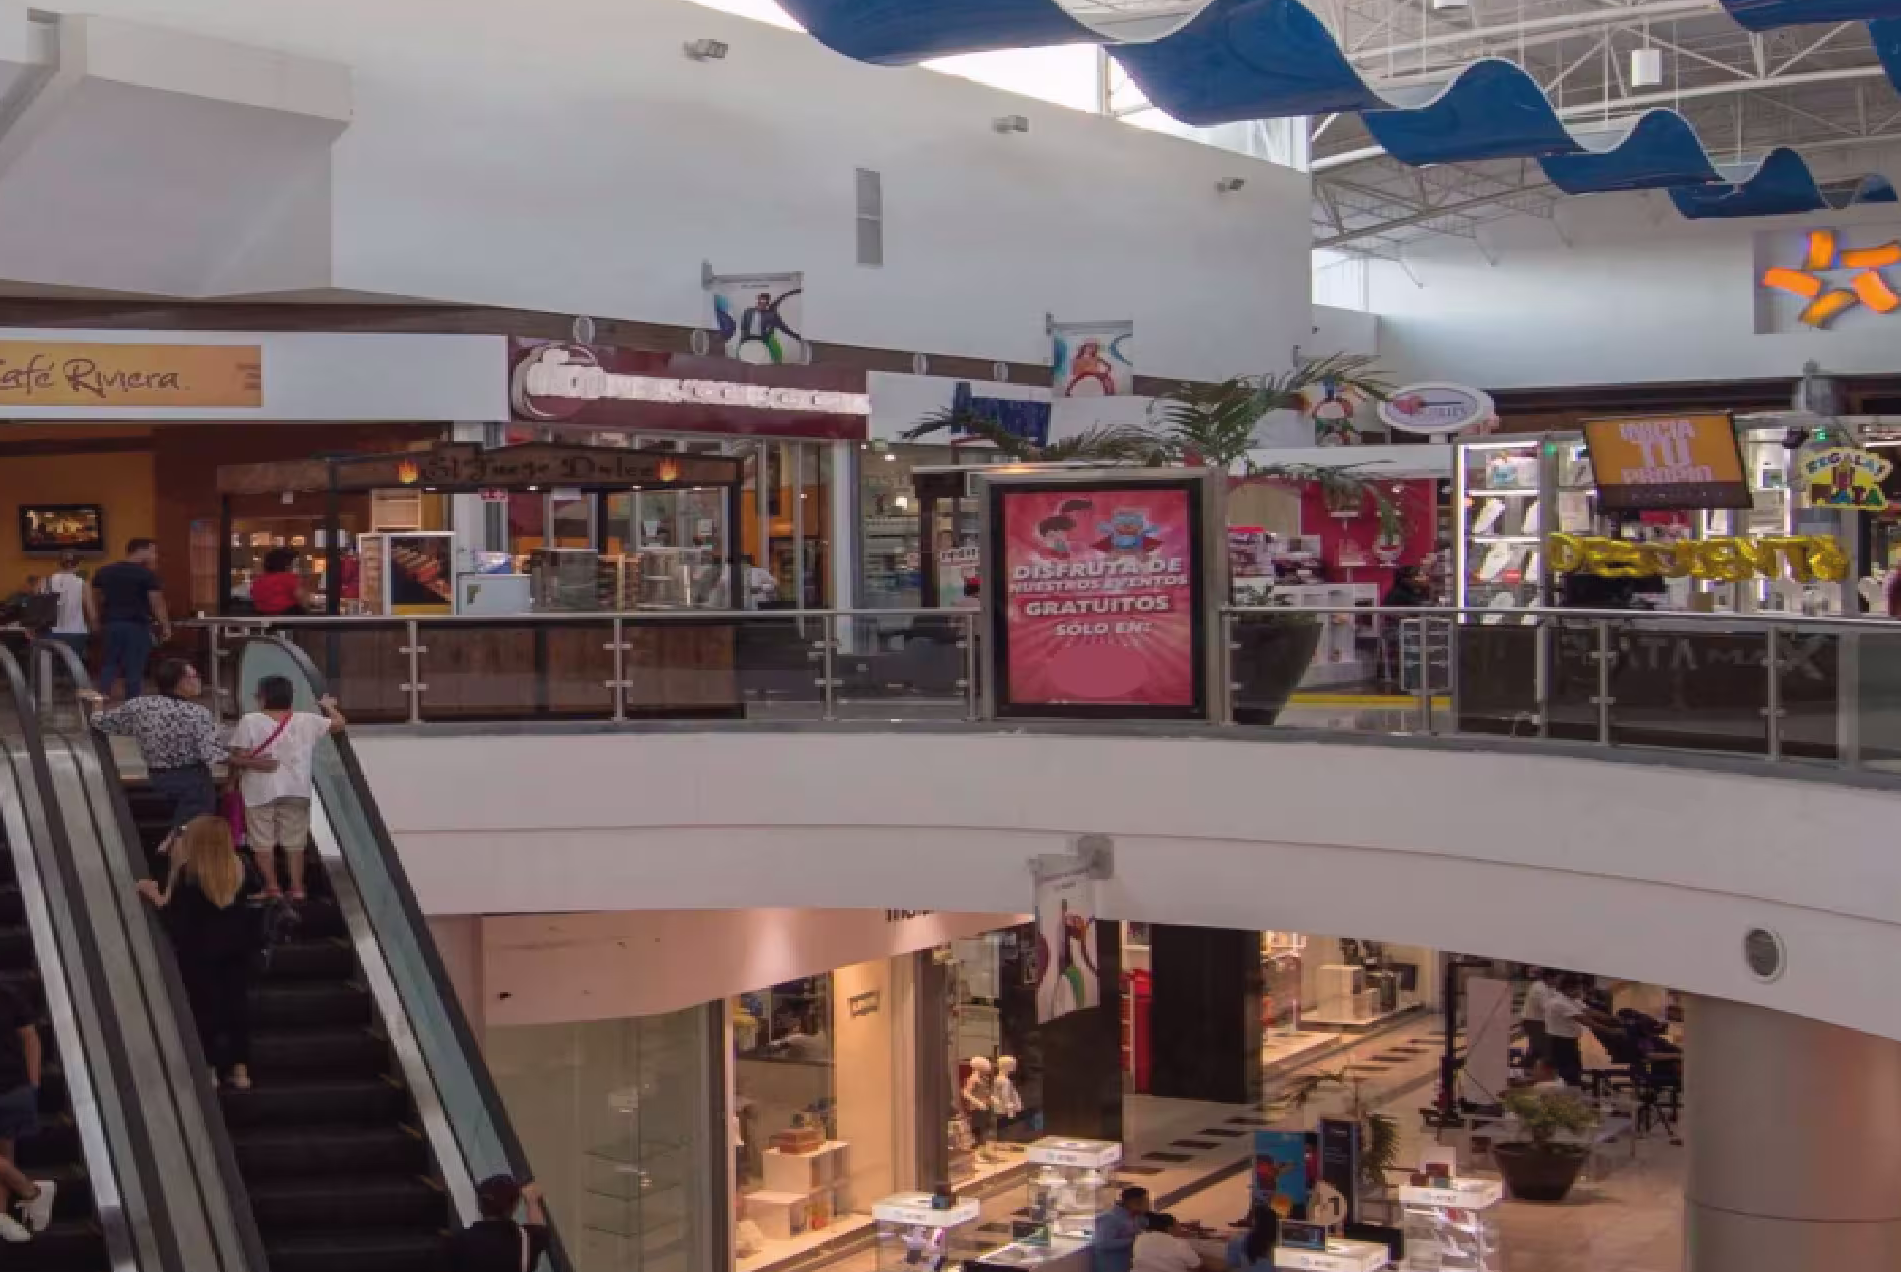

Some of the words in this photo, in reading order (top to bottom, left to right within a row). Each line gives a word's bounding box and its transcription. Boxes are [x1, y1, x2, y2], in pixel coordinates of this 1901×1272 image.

[61, 358, 180, 398] Riviera
[1012, 556, 1139, 580] DISFRUTA
[1147, 556, 1183, 574] DE
[1025, 594, 1170, 617] GRATUITOS
